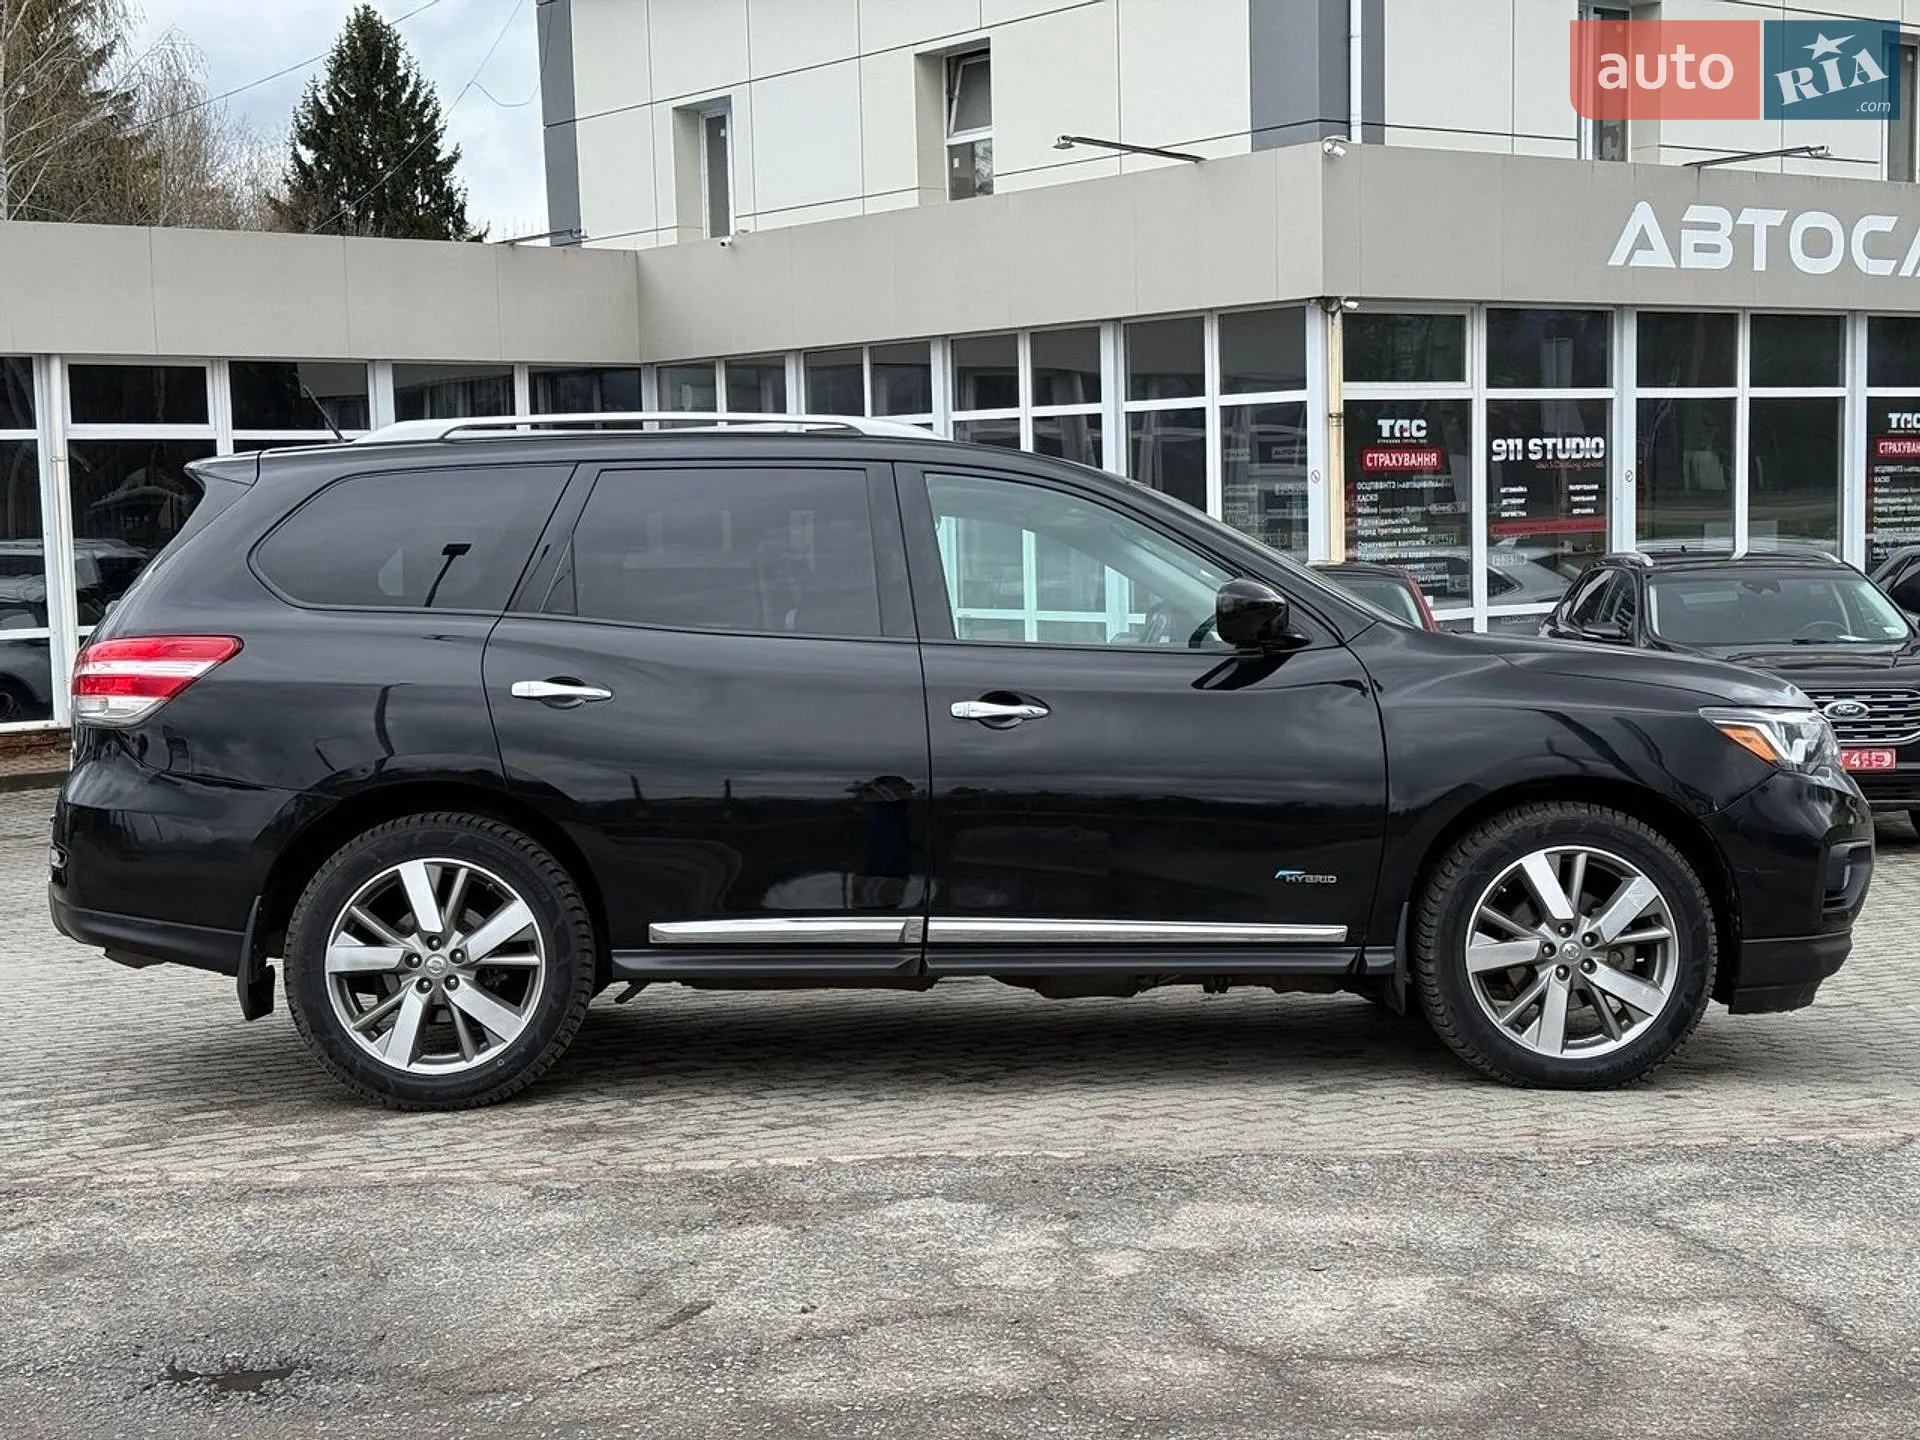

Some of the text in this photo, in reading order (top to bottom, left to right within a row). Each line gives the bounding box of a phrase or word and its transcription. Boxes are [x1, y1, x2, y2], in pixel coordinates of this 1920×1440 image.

[1492, 437, 1605, 461] 911 STUDIO
[1366, 453, 1437, 467] СТРАХУВАННЯ
[1285, 874, 1337, 883] HYBRID
